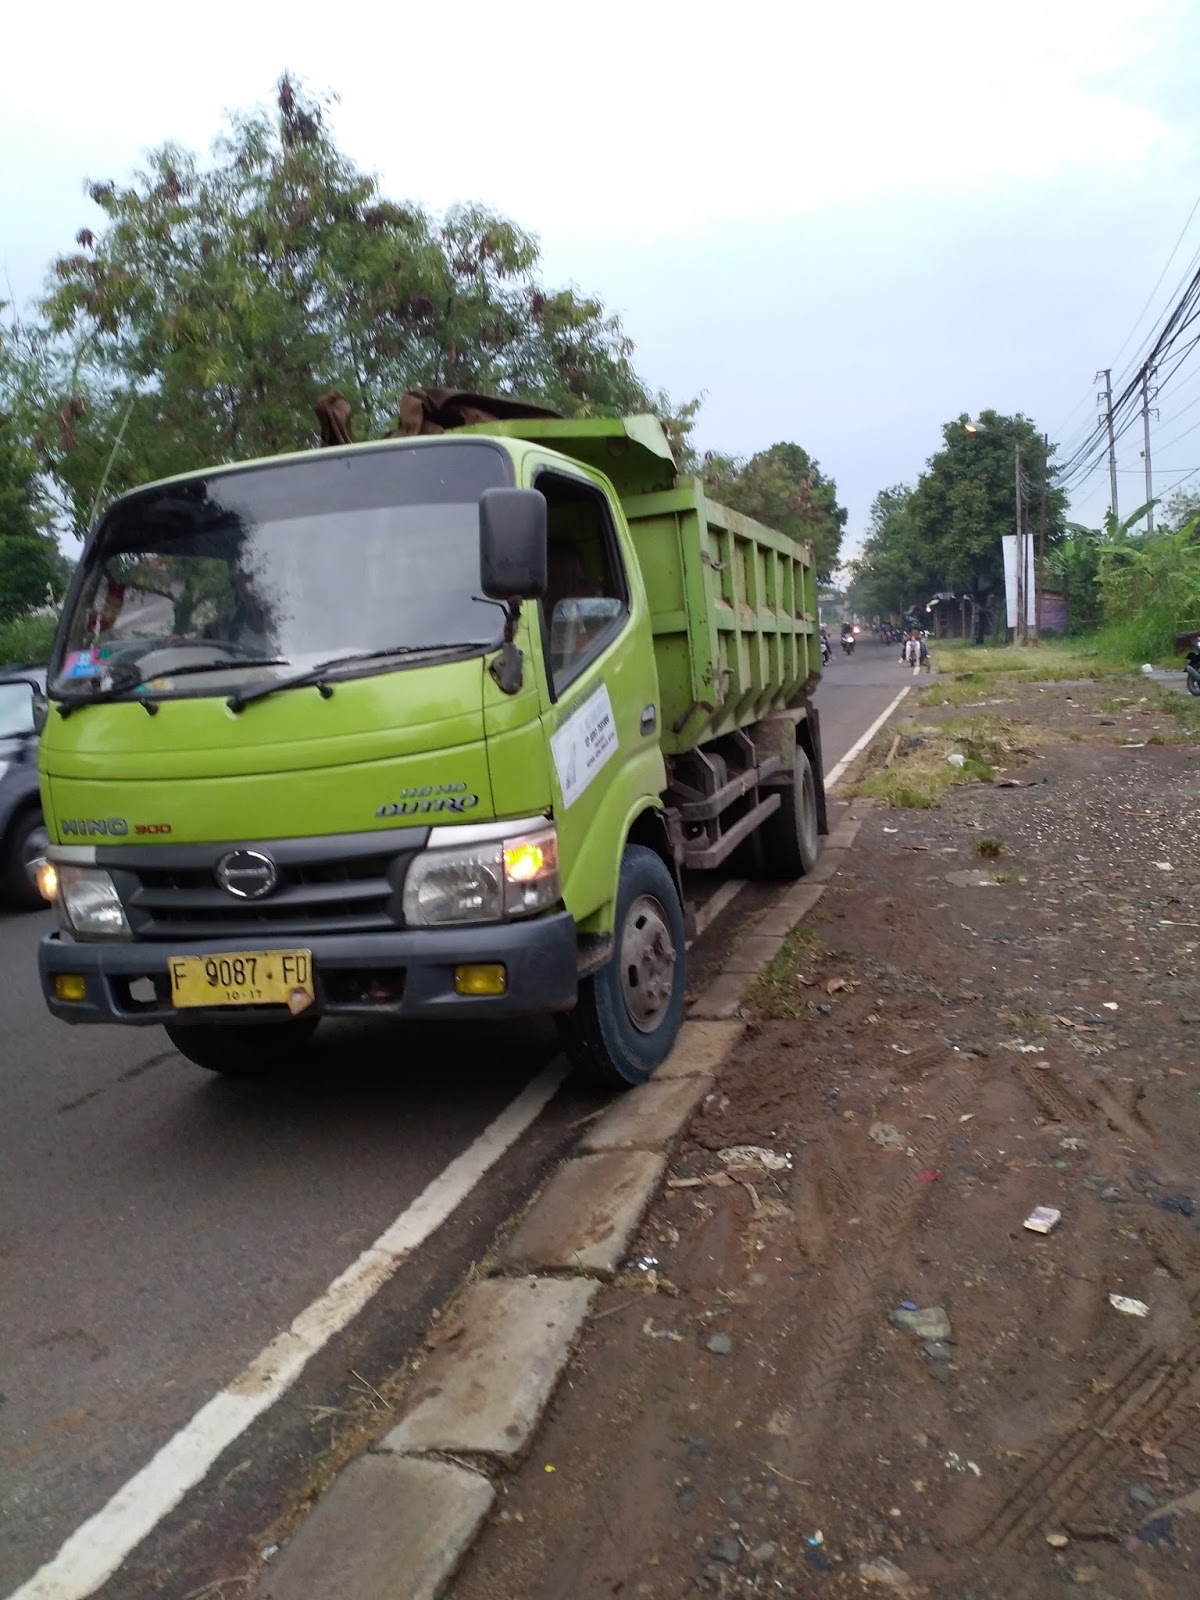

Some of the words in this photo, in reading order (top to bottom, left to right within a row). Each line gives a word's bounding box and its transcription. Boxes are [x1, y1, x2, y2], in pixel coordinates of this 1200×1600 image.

[375, 794, 480, 817] DUTRO
[61, 817, 128, 836] HINO
[135, 824, 172, 834] 300
[172, 962, 187, 990] F
[205, 957, 257, 987] 9087
[282, 955, 308, 984] FD
